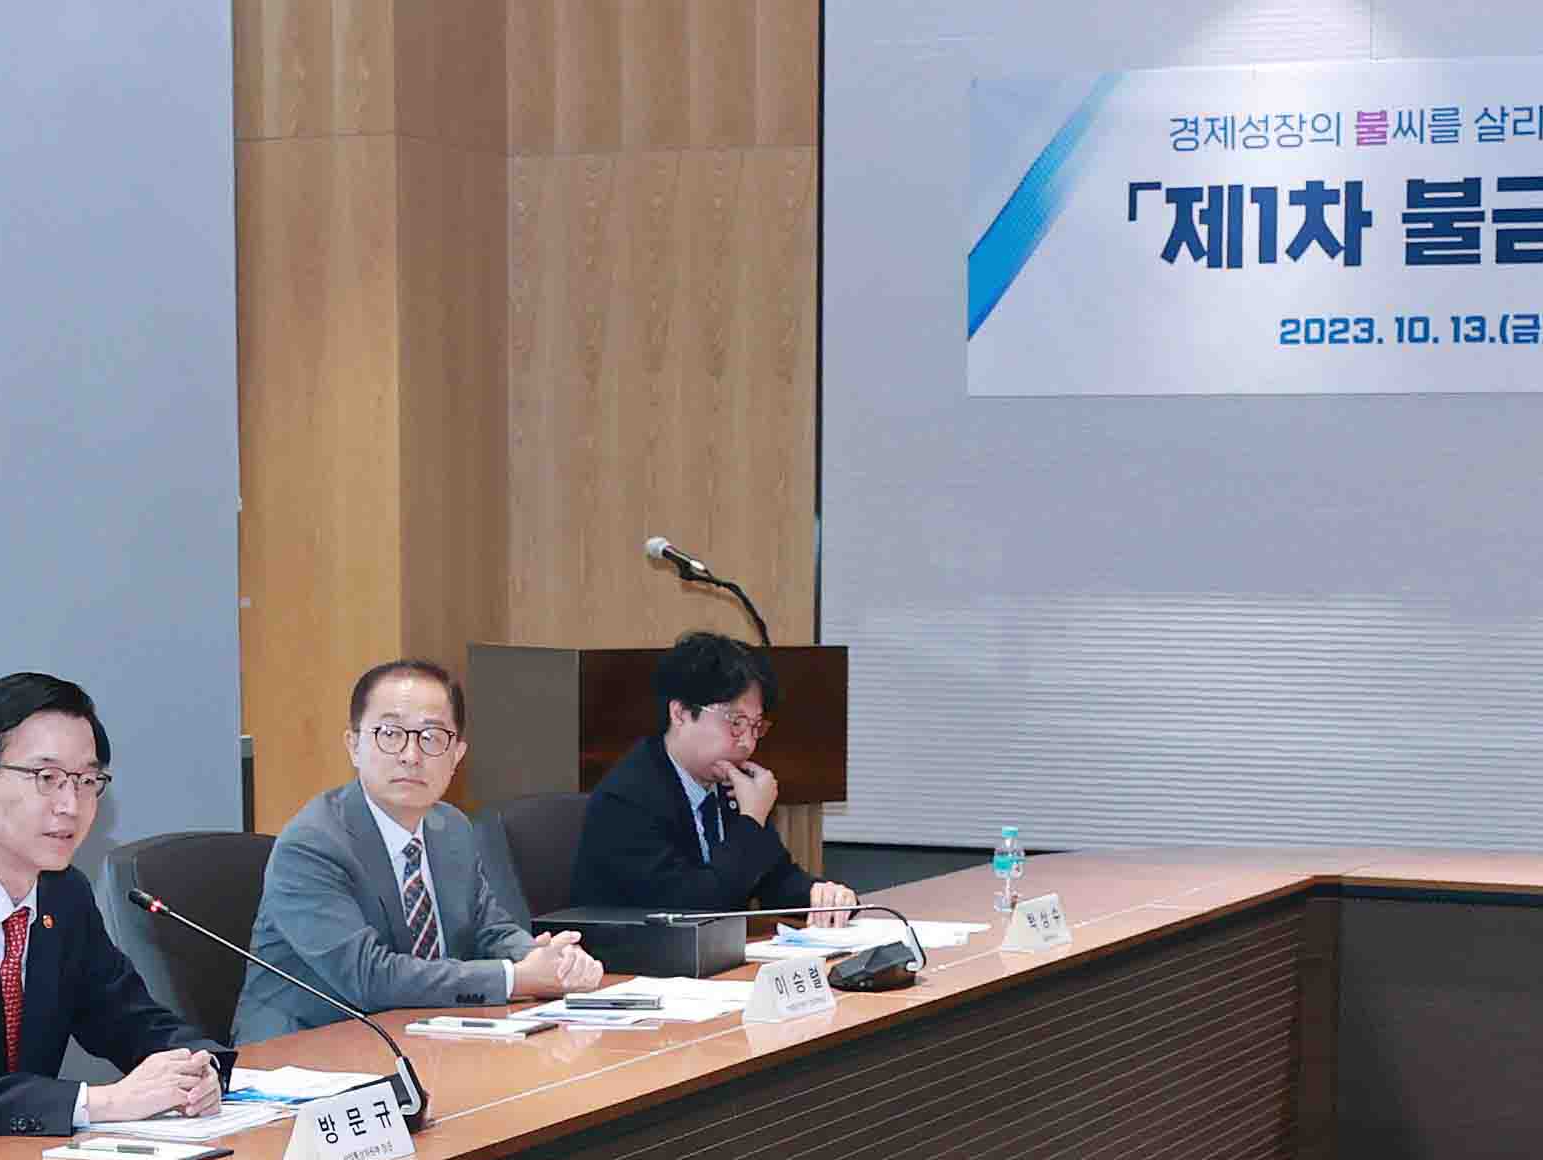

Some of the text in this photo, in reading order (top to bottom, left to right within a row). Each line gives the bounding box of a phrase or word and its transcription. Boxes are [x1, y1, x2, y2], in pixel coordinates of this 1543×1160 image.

[1169, 110, 1343, 152] 경제성장의
[1354, 105, 1462, 147] 불씨를
[1278, 313, 1385, 346] 2023.
[1393, 314, 1440, 345] 10.
[318, 1100, 392, 1144] 방문규
